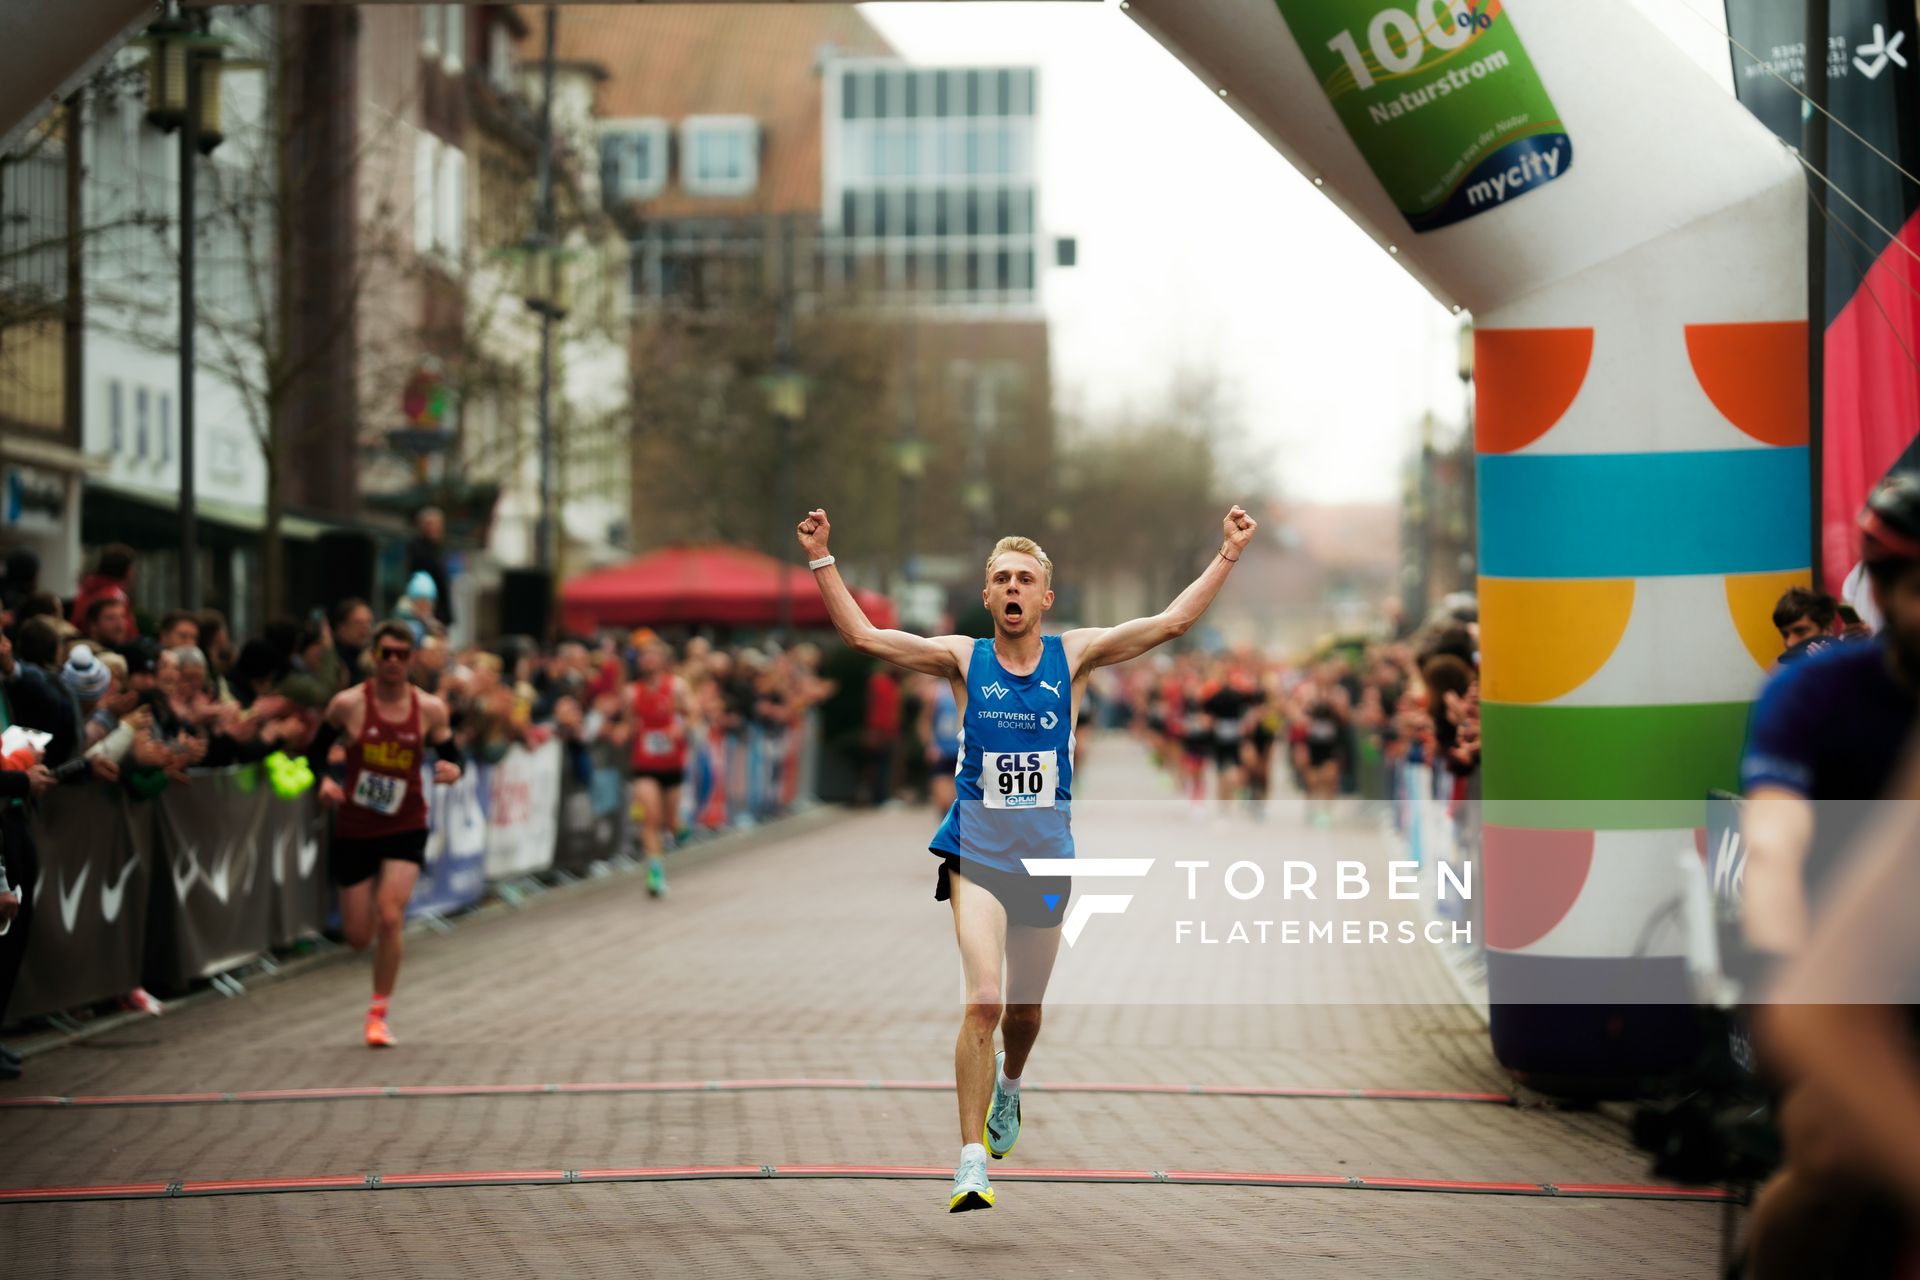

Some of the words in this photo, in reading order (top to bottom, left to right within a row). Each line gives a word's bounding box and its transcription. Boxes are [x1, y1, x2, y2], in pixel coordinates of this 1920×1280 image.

[1368, 50, 1509, 124] Naturstrom
[1495, 112, 1529, 133] Natur
[1466, 146, 1560, 206] mycity
[977, 711, 1036, 721] STADTWERKE
[997, 720, 1036, 730] BOCHUM
[996, 753, 1040, 772] GLS
[998, 771, 1043, 795] 910
